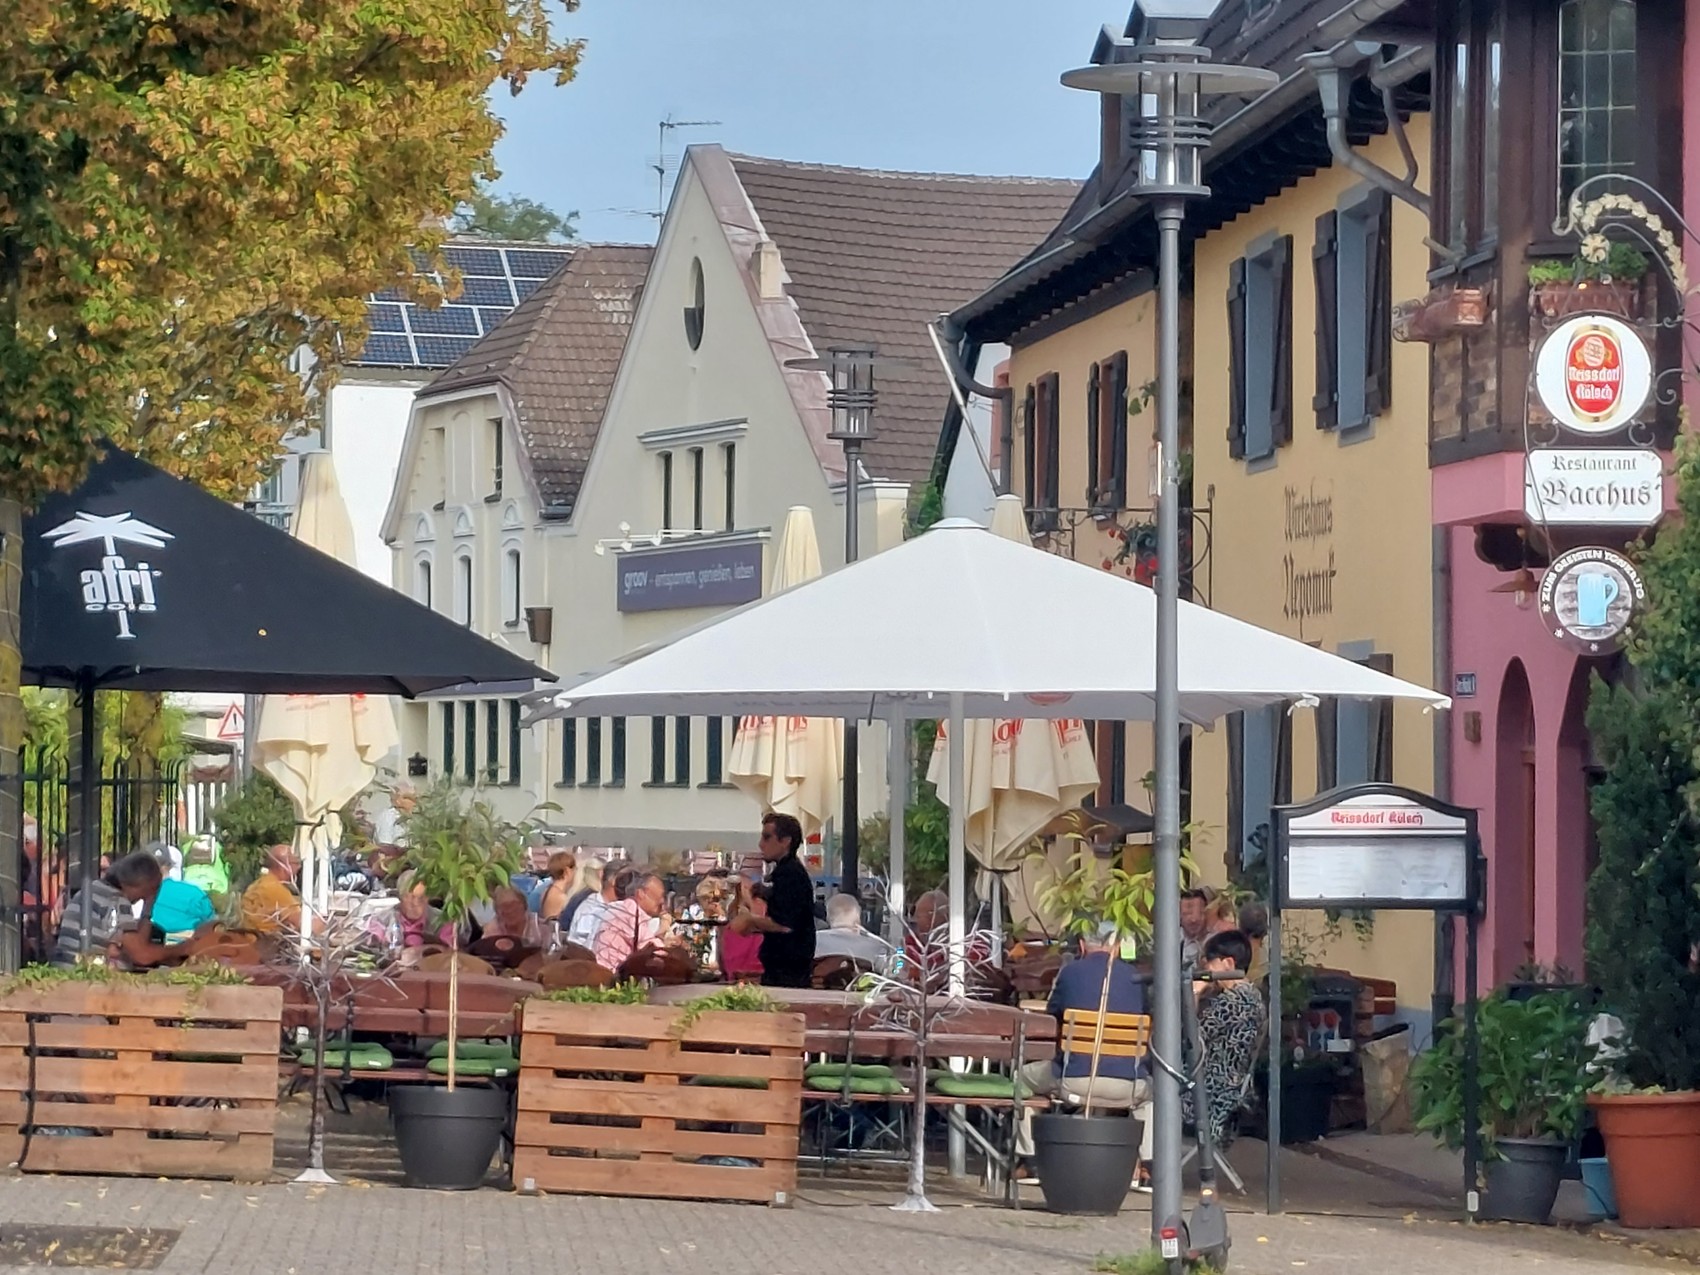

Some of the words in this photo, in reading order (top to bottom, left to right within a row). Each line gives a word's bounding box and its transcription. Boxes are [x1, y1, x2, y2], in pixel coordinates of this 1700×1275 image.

[1568, 366, 1620, 382] Reissdorf
[1576, 383, 1613, 400] Kölsch
[1552, 455, 1638, 471] Restaurant
[1541, 477, 1652, 512] Bacchus
[80, 556, 155, 604] afri
[1541, 571, 1557, 602] ZUM
[1331, 811, 1385, 825] Reissdorf
[1389, 811, 1424, 826] Kölsch
